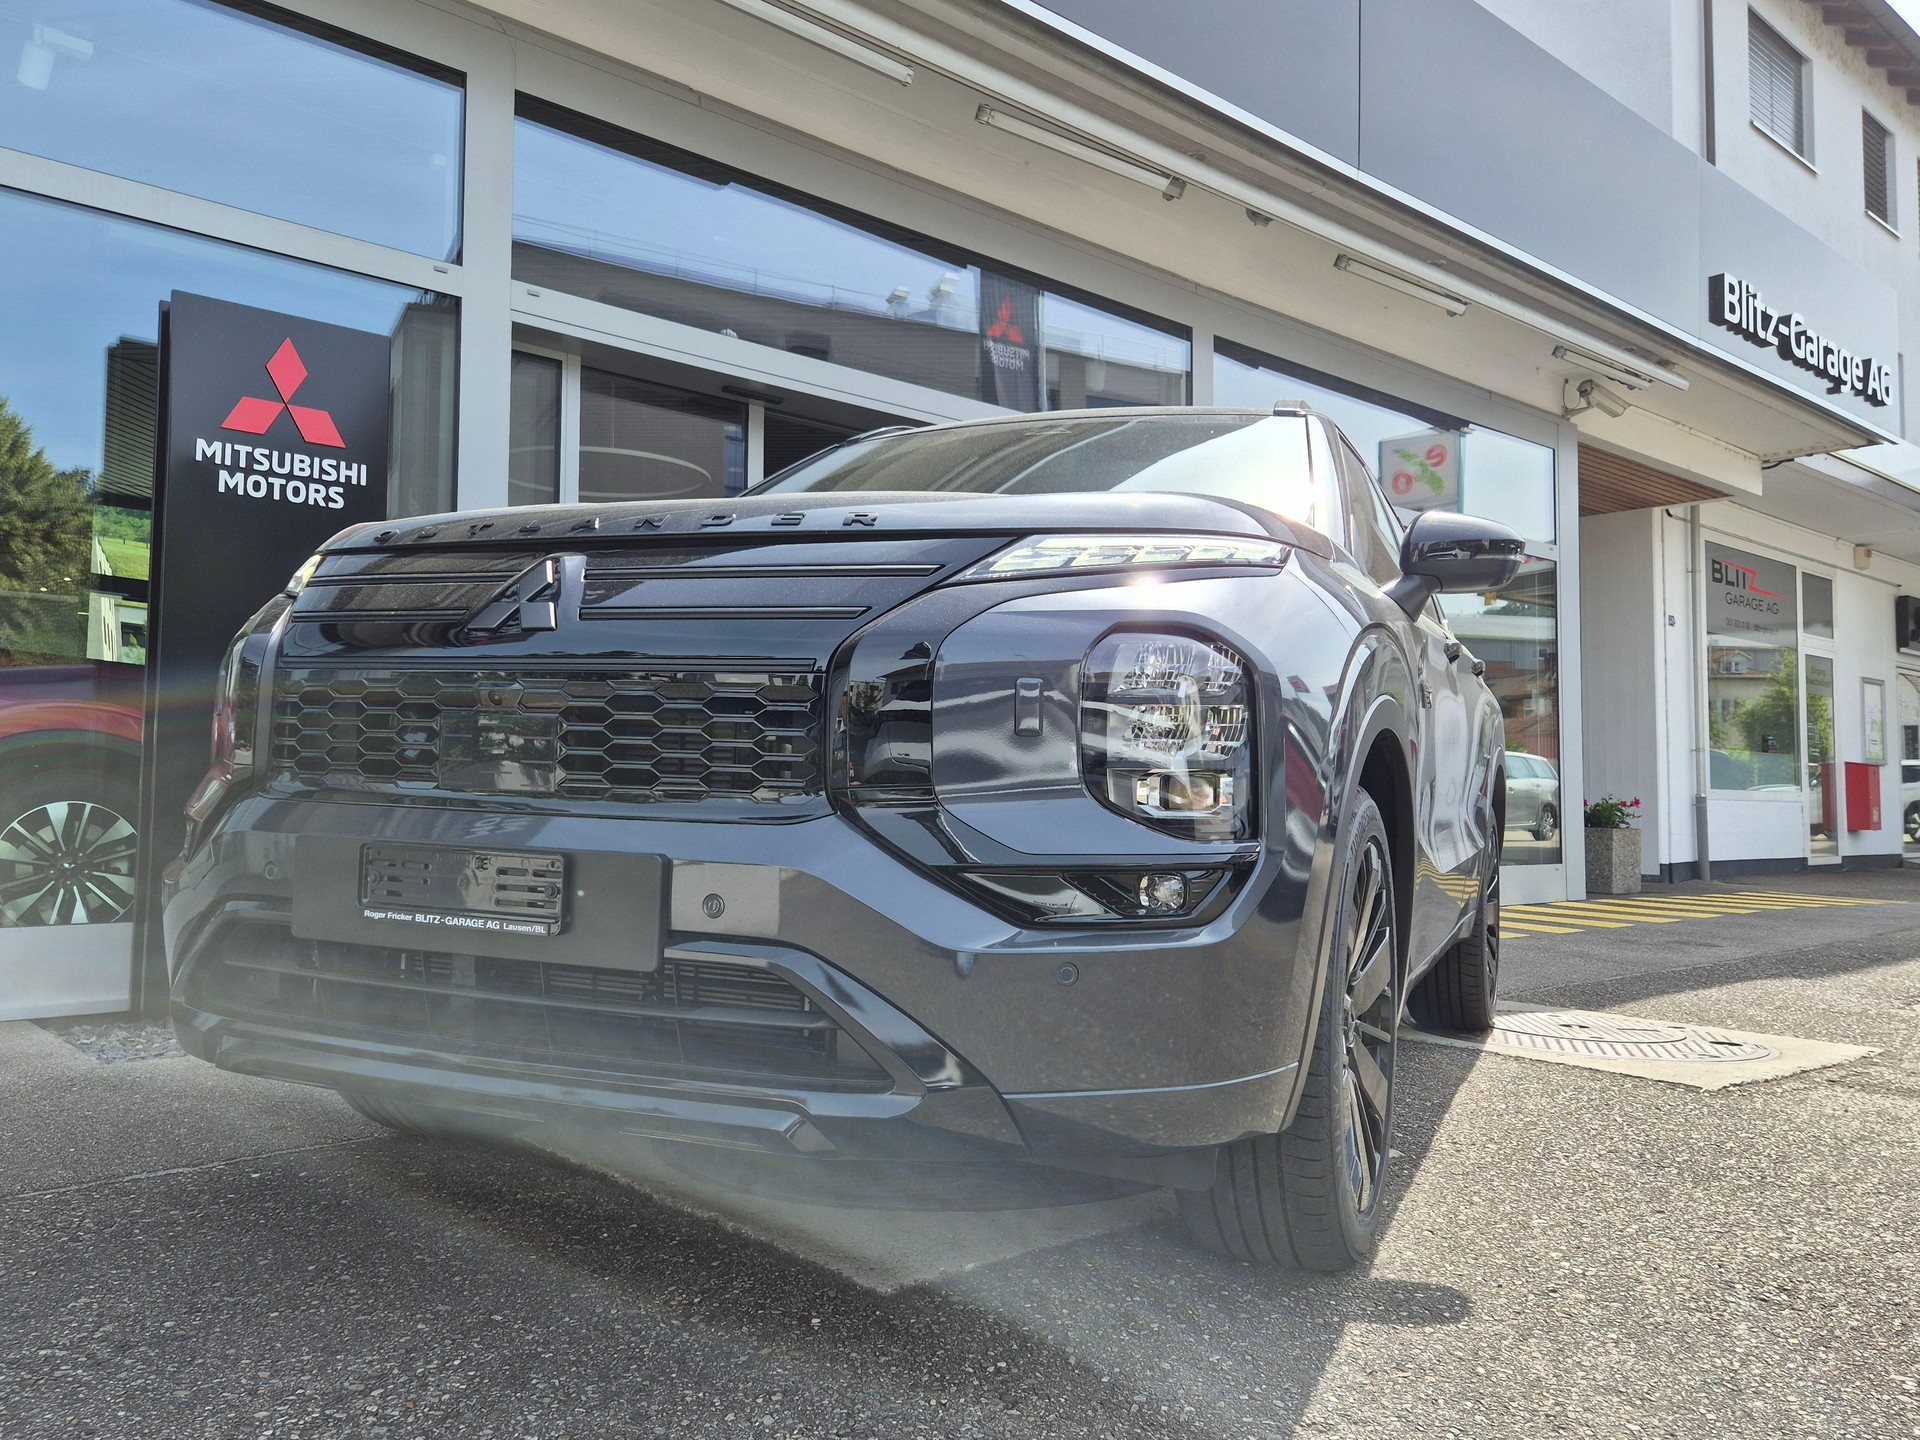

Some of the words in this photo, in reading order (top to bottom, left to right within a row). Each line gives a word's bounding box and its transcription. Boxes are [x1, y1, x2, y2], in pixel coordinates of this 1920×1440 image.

[1722, 272, 1864, 394] Blitz-Garage
[1867, 357, 1893, 407] AG
[195, 438, 367, 486] MITSUBISHI
[218, 469, 345, 509] MOTORS
[373, 511, 879, 543] OUTLANDER
[1725, 592, 1764, 612] GARAGE
[1766, 602, 1779, 615] AG
[364, 909, 386, 920] Roger
[387, 912, 413, 922] Fricker
[415, 913, 485, 929] BLITZ-GARAGE
[486, 919, 500, 930] AG
[503, 922, 546, 934] Lausen/BL
